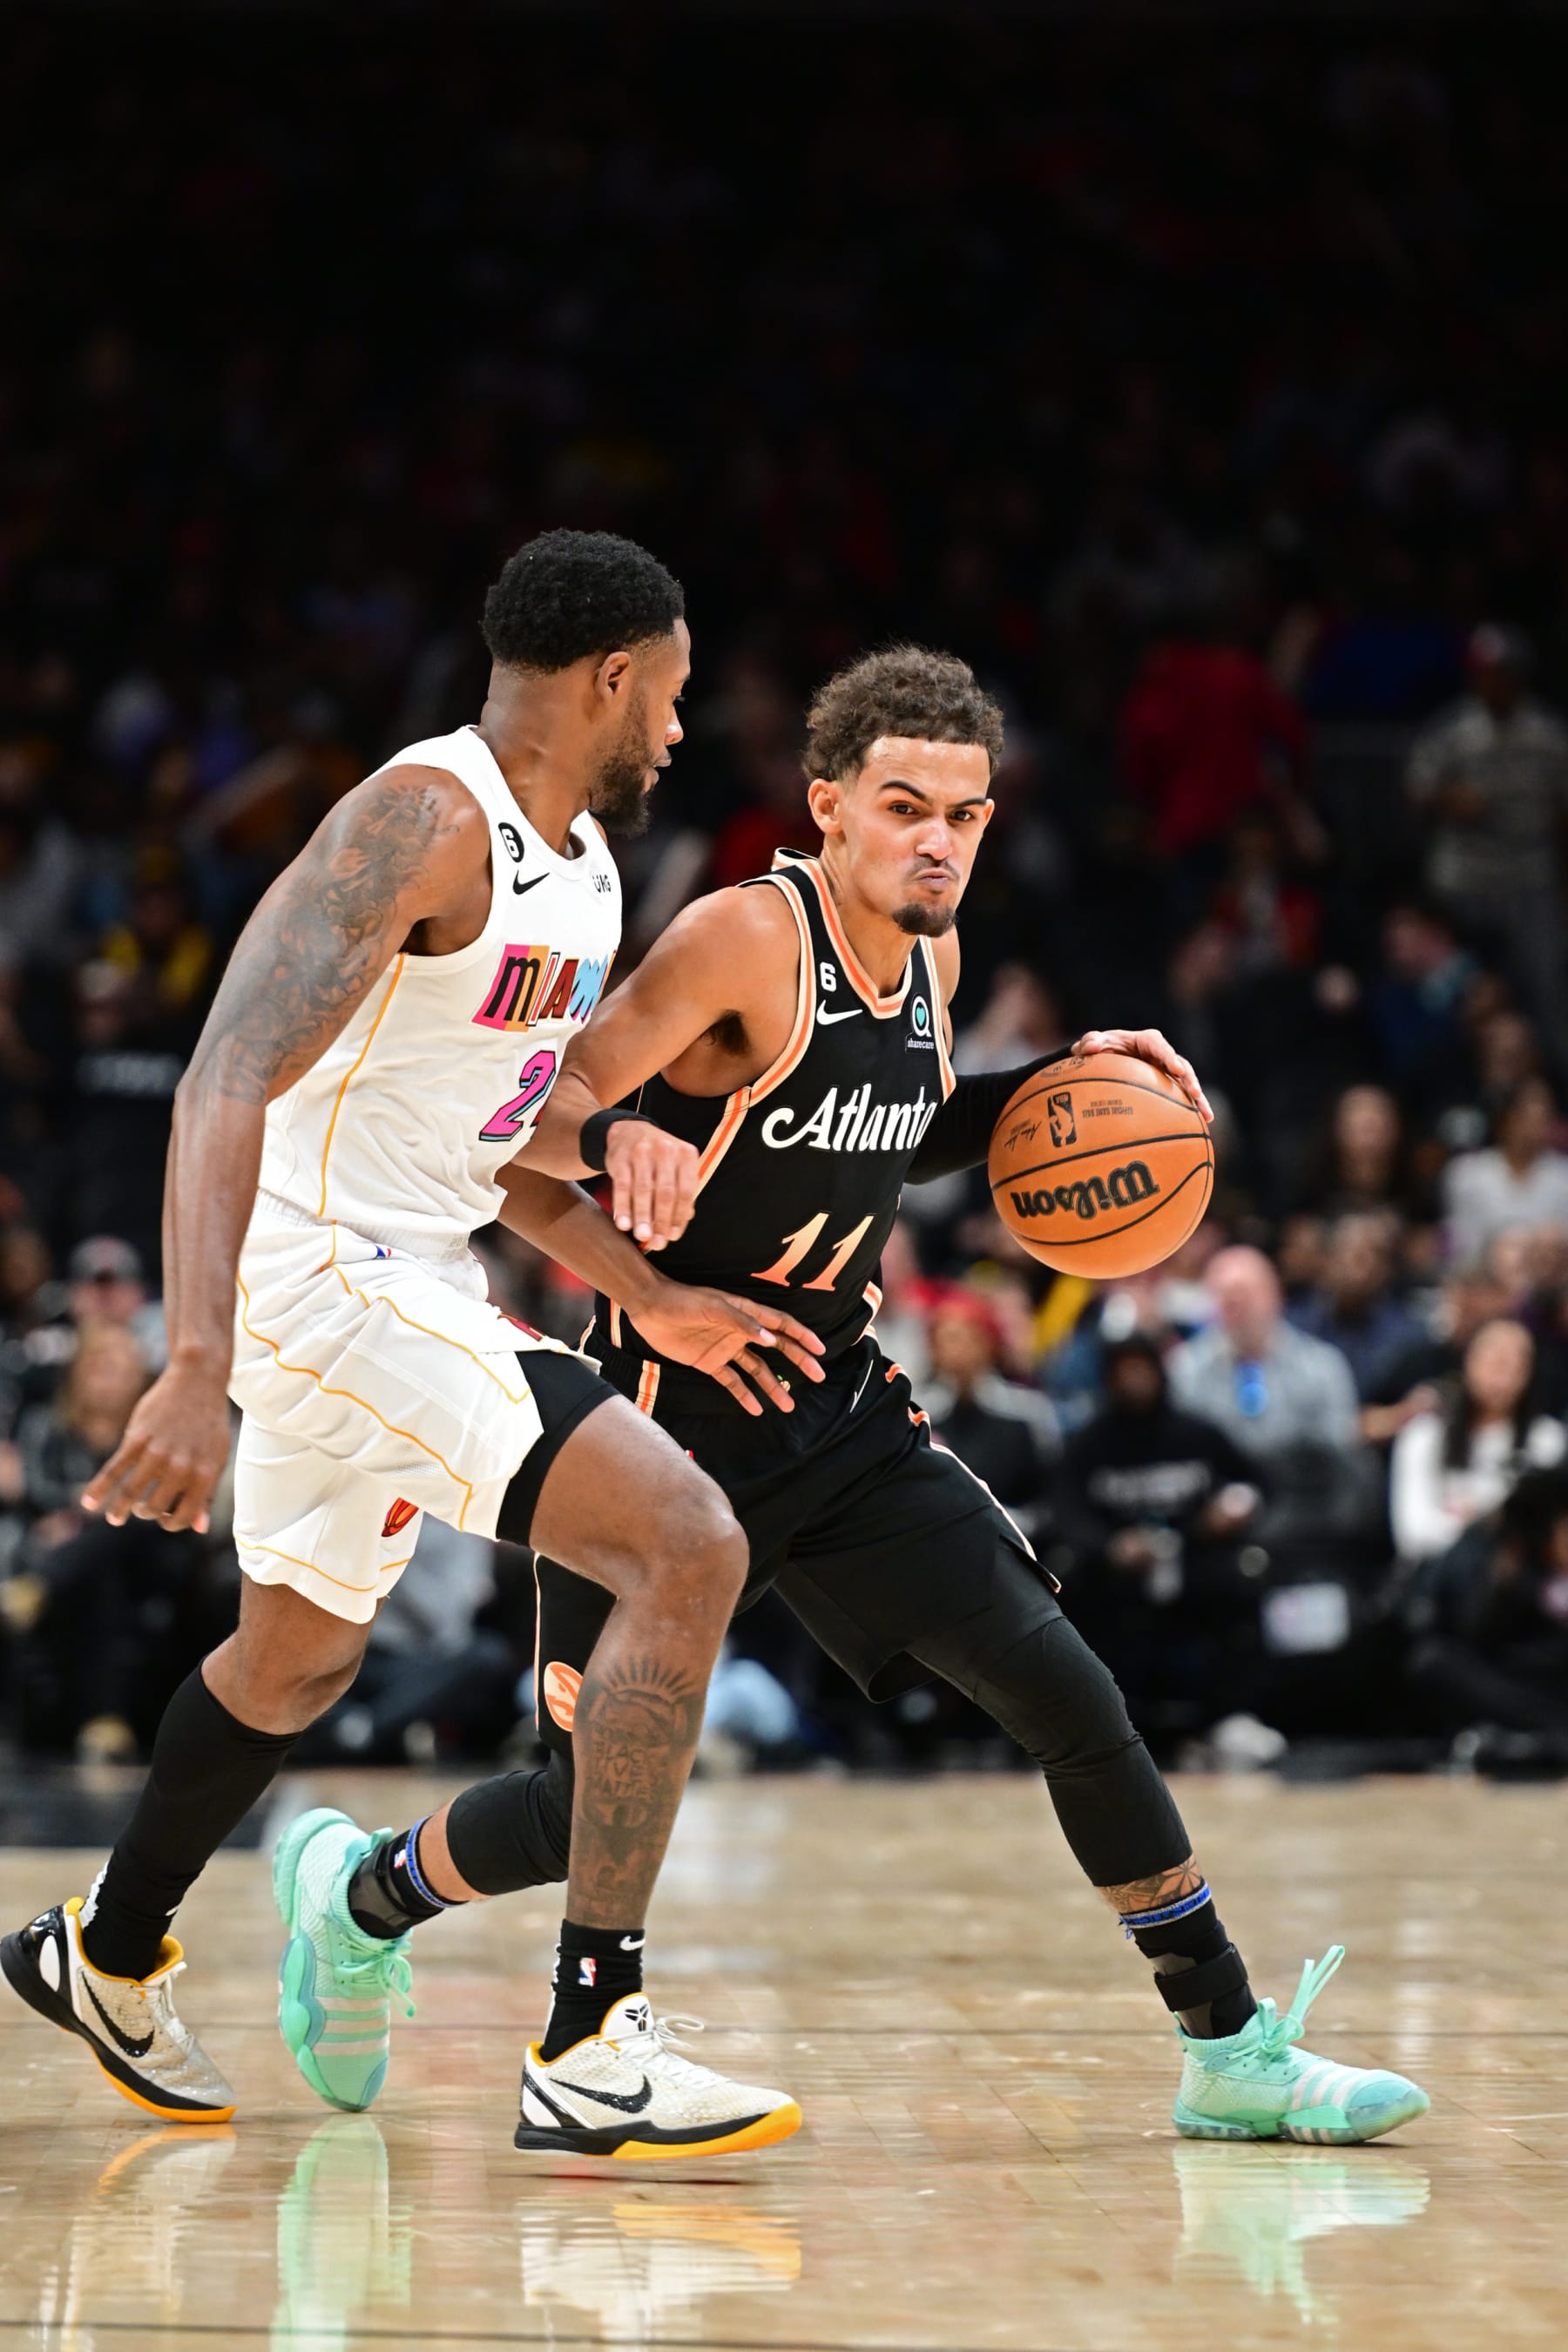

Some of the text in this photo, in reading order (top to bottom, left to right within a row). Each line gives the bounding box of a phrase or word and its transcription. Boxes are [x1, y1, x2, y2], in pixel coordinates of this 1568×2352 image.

[501, 828, 520, 858] 6
[483, 949, 616, 1028] MIAM
[819, 962, 837, 992] 6
[907, 1037, 935, 1050] sharecare
[479, 1050, 556, 1142] 2
[1010, 1160, 1160, 1220] Wilson
[750, 1212, 875, 1292] 11
